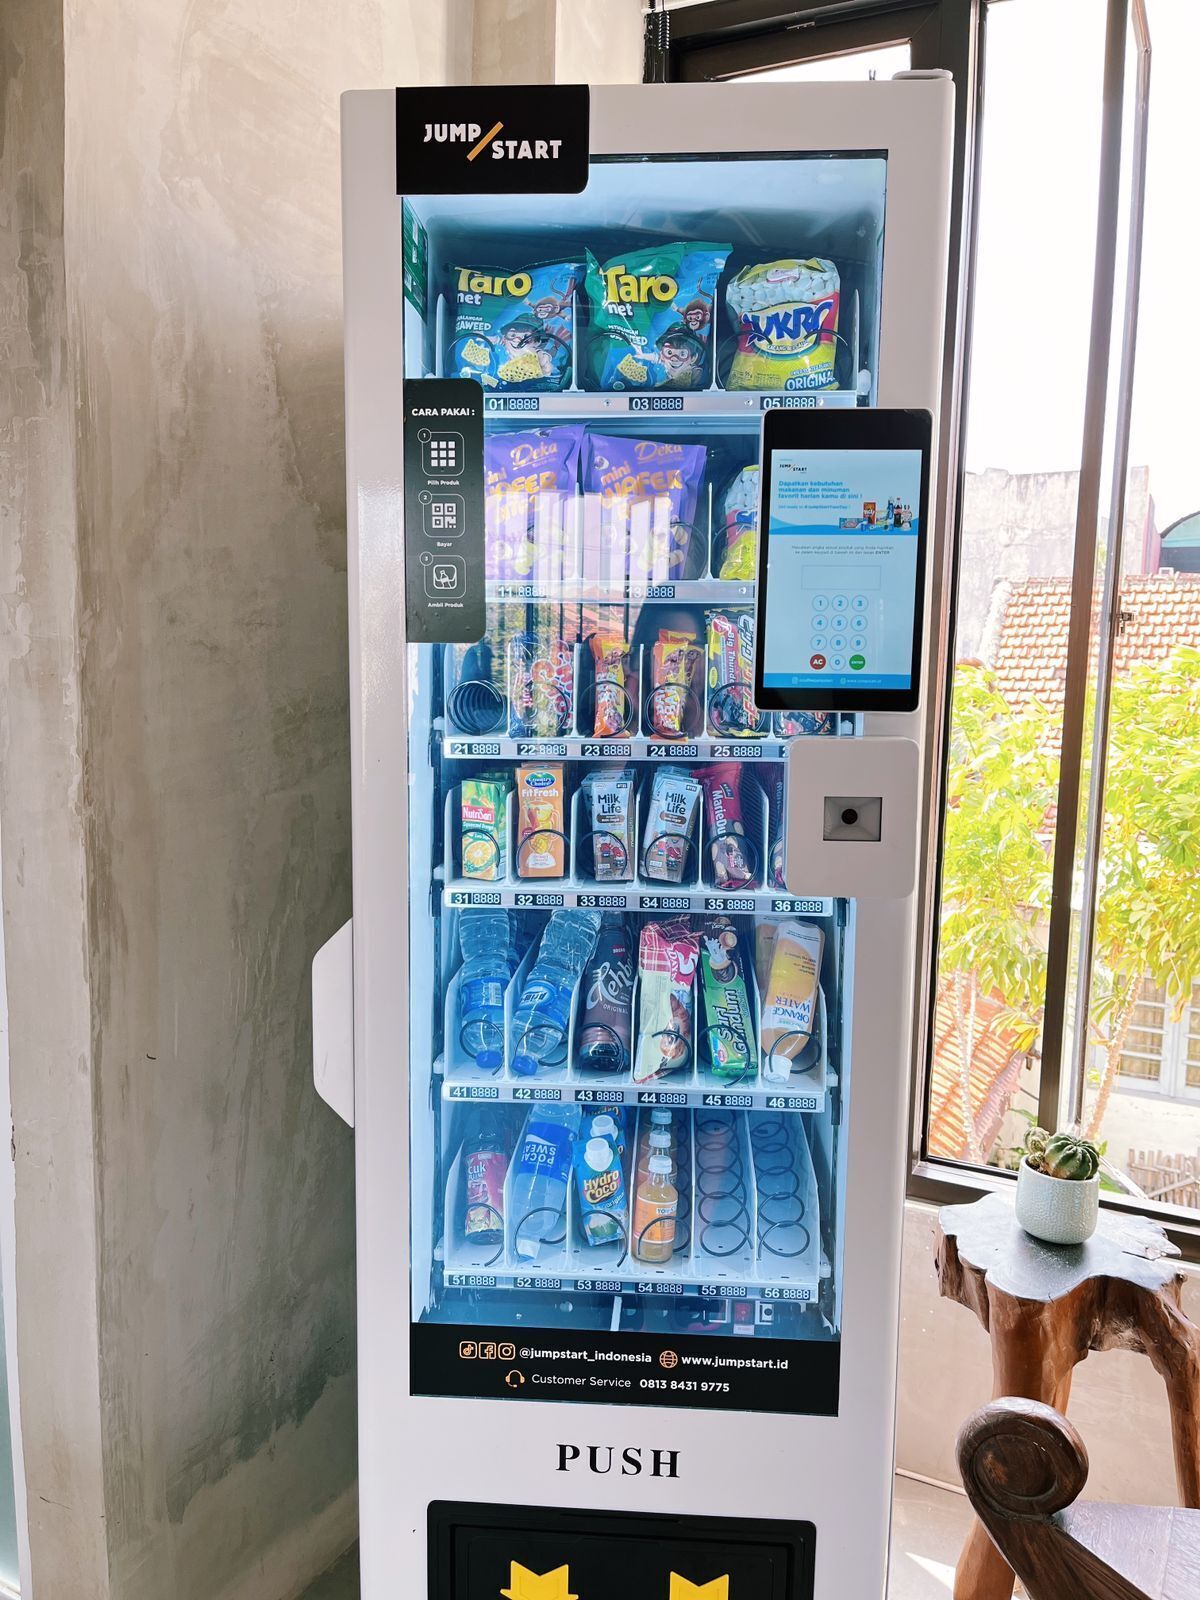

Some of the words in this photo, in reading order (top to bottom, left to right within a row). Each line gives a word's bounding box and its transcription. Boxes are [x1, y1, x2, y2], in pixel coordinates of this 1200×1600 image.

[424, 124, 482, 143] JUMP
[492, 140, 562, 159] START
[454, 266, 532, 297] Taro
[602, 265, 678, 303] Taro
[456, 292, 482, 305] net
[608, 302, 634, 317] net
[786, 370, 835, 391] ORIGINA
[489, 400, 504, 410] 01
[509, 399, 538, 409] 8888
[632, 399, 649, 410] 03
[653, 398, 682, 410] 8888
[763, 398, 781, 408] 05
[412, 408, 438, 416] CARA
[440, 408, 470, 416] PAKAI
[510, 442, 558, 466] Deka
[600, 460, 631, 485] mini
[454, 744, 468, 755] 21
[472, 744, 499, 754] 8888
[520, 745, 536, 755] 22
[540, 745, 566, 755] 8888
[584, 745, 600, 756] 23
[603, 745, 630, 756] 8888
[650, 746, 666, 756] 24
[670, 746, 697, 756] 8888
[714, 746, 730, 757] 25
[734, 746, 761, 757] 8888
[598, 794, 621, 804] Milk
[665, 792, 687, 805] Milk
[602, 804, 622, 814] Life
[666, 802, 686, 815] Life
[455, 894, 469, 904] 31
[473, 894, 500, 904] 8888
[518, 895, 532, 905] 32
[536, 895, 563, 905] 8888
[581, 896, 596, 906] 33
[599, 896, 626, 906] 8888
[642, 898, 658, 908] 34
[662, 898, 689, 908] 8888
[708, 899, 724, 910] 35
[727, 899, 754, 910] 8888
[774, 901, 791, 911] 36
[794, 901, 822, 912] 8888
[603, 1004, 629, 1014] ORIGINAL
[776, 996, 810, 1012] WATER
[772, 1008, 810, 1024] ORANGE
[712, 1006, 733, 1042] Sari
[453, 1088, 467, 1097] 41
[472, 1088, 498, 1097] 8888
[516, 1089, 530, 1098] 42
[534, 1089, 560, 1098] 8888
[578, 1091, 593, 1100] 43
[597, 1092, 623, 1101] 8888
[641, 1093, 657, 1103] 44
[660, 1094, 686, 1103] 8888
[706, 1096, 721, 1106] 45
[725, 1096, 752, 1106] 8888
[769, 1098, 785, 1108] 46
[789, 1098, 815, 1108] 8888
[523, 1144, 557, 1156] SWEA
[521, 1152, 554, 1165] POCA
[468, 1162, 486, 1175] cuk
[584, 1170, 619, 1190] Hydro
[586, 1181, 618, 1204] Coco
[452, 1276, 466, 1285] 51
[470, 1276, 495, 1286] 8888
[517, 1278, 531, 1288] 52
[535, 1279, 560, 1288] 8888
[578, 1281, 592, 1290] 53
[596, 1282, 621, 1290] 8888
[638, 1283, 653, 1293] 54
[657, 1284, 682, 1293] 8888
[702, 1286, 716, 1295] 55
[720, 1287, 746, 1296] 8888
[765, 1289, 780, 1298] 56
[783, 1290, 809, 1299] 8888
[519, 1348, 652, 1362] @jumpstart_indonesia
[681, 1356, 789, 1369] www.jumpstart.id
[532, 1374, 586, 1386] Customer
[590, 1376, 631, 1388] Service
[640, 1379, 667, 1389] 0813
[670, 1380, 697, 1391] 8431
[701, 1382, 730, 1392] 9775
[556, 1443, 681, 1478] PUSH
